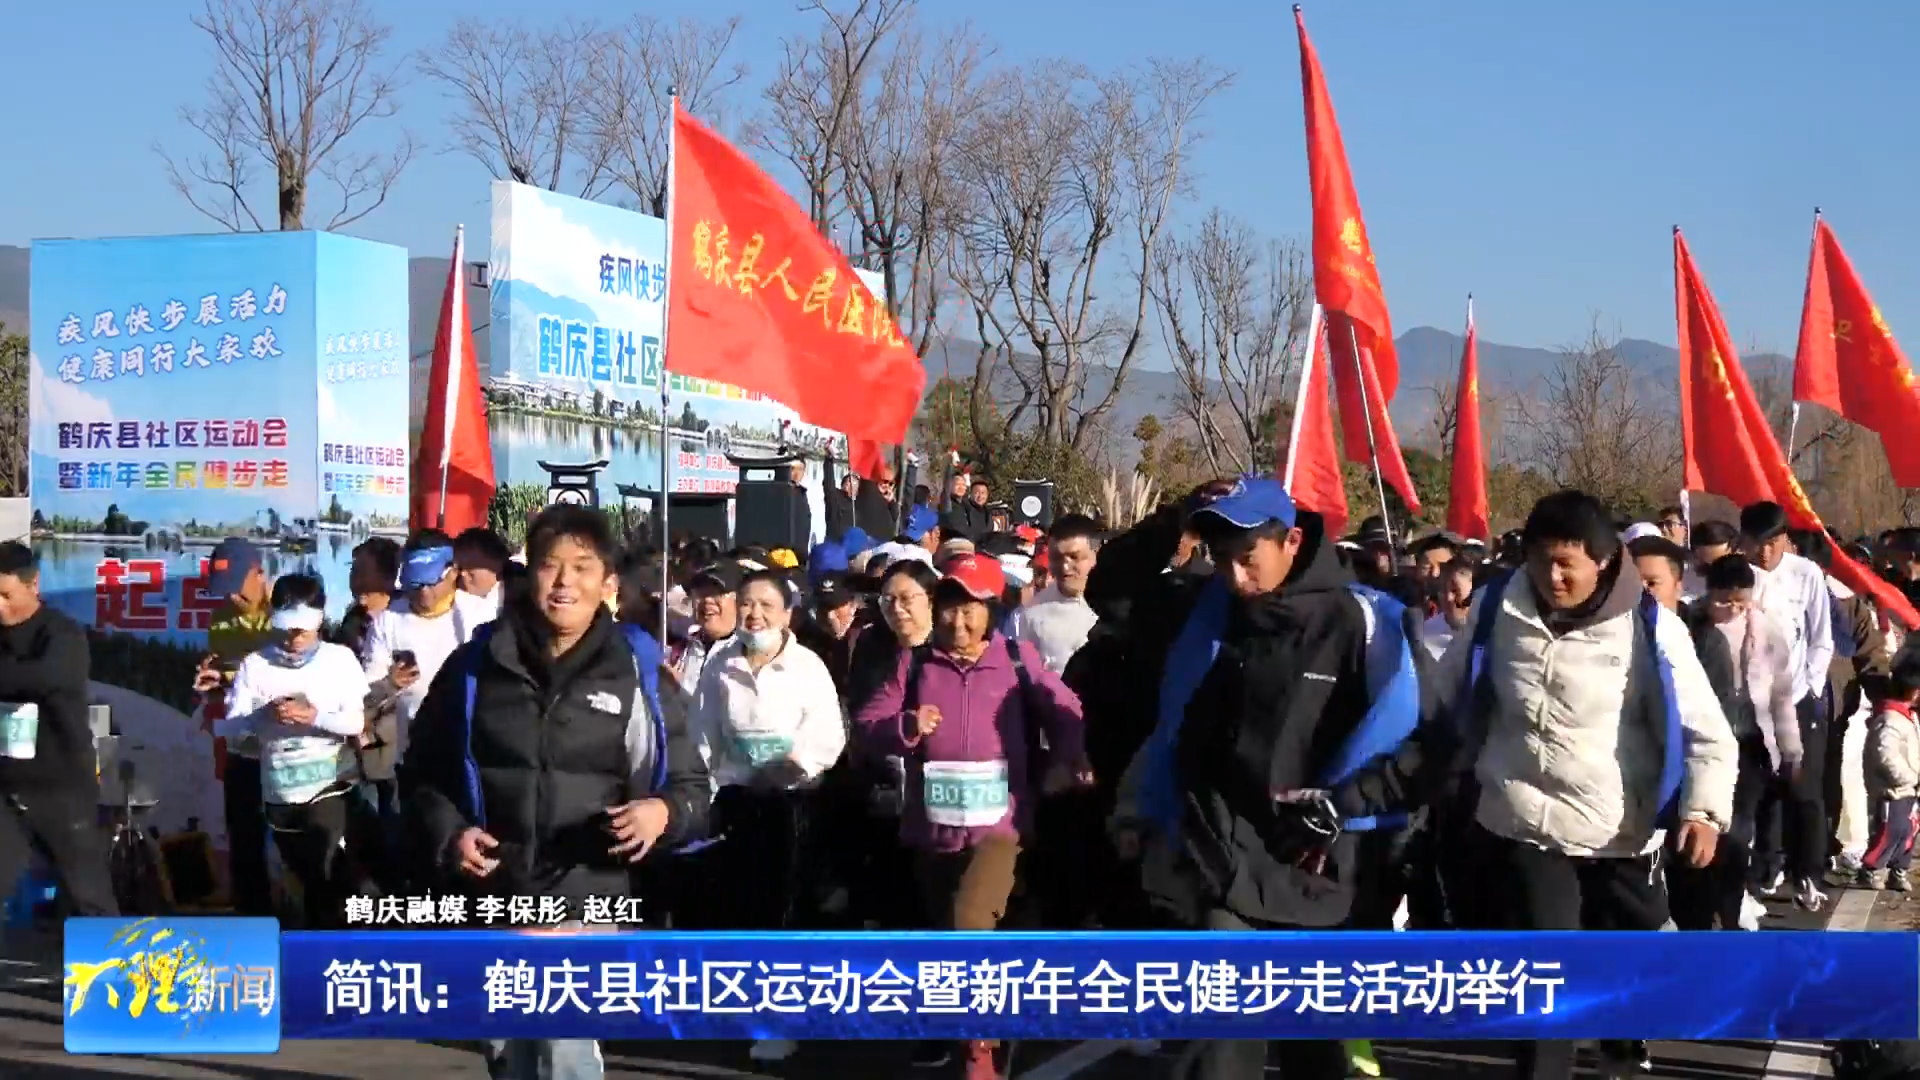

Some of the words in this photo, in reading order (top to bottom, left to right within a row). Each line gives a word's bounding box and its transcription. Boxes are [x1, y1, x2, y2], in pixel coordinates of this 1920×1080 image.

[57, 283, 288, 345] 疾风快步展活力
[57, 326, 284, 384] 健康同行大家欢
[57, 417, 289, 450] 鹤庆县社区运动会
[323, 442, 405, 467] 鹤庆县社区运动会
[57, 459, 289, 490] 暨新年全民健步走
